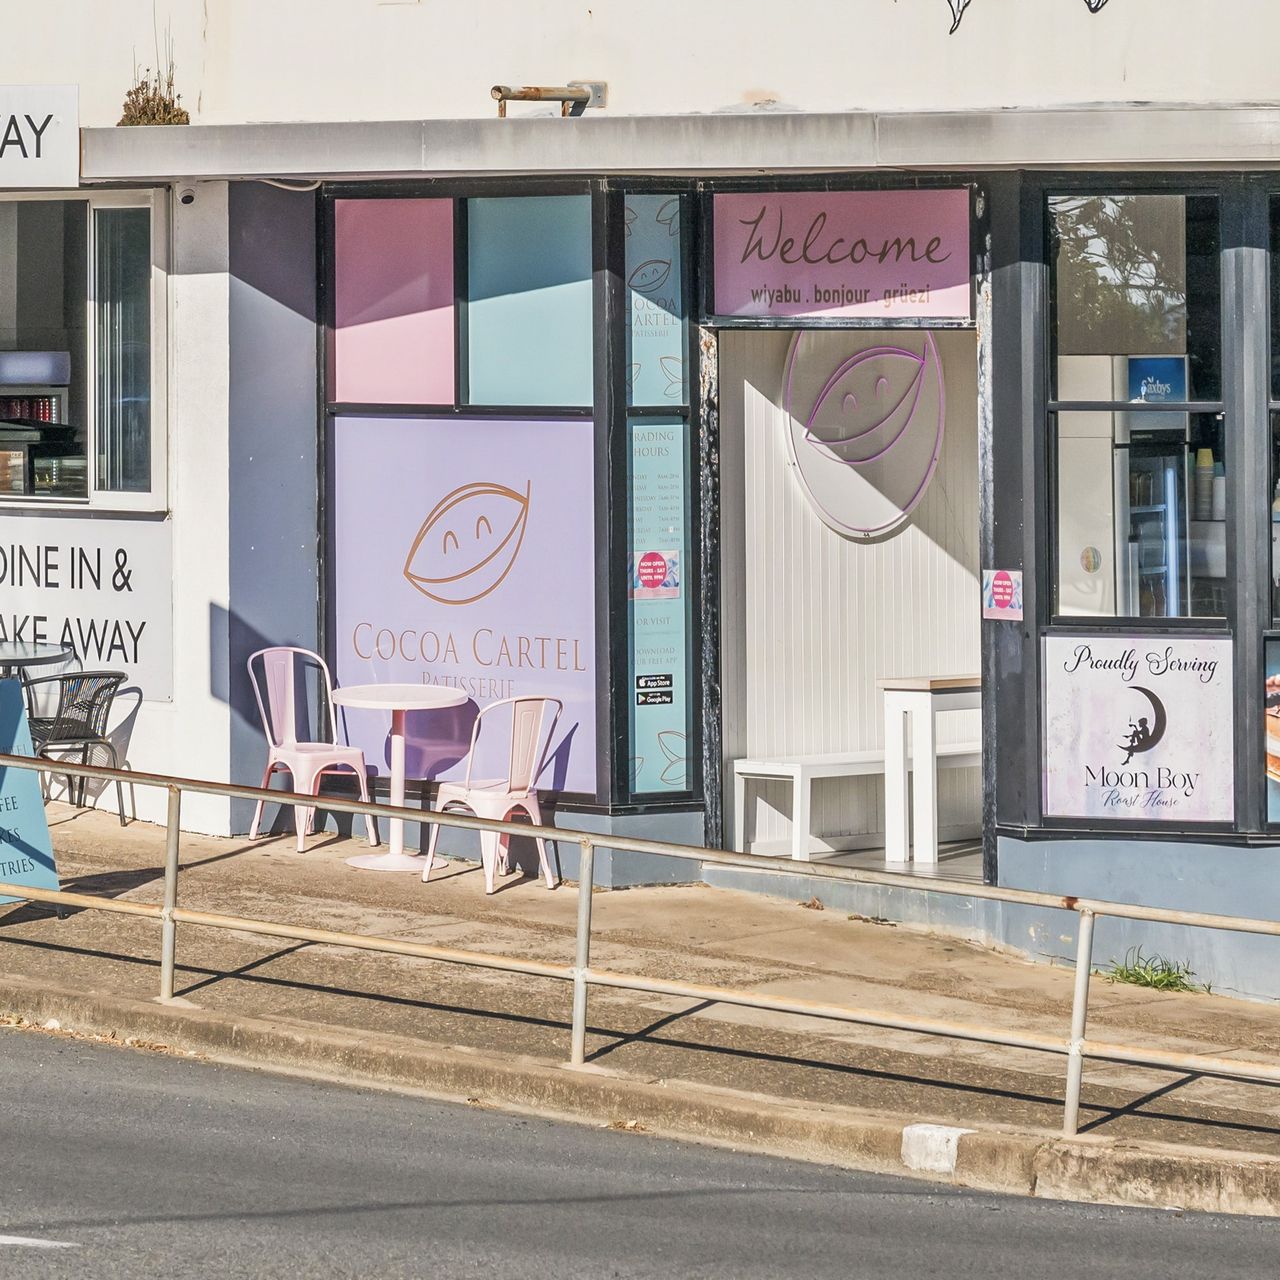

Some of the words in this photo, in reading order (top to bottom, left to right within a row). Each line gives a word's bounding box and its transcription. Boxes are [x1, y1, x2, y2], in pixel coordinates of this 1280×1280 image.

[738, 205, 952, 264] Welcome
[627, 297, 677, 311] OCOA
[751, 284, 801, 308] wiyabu
[815, 284, 870, 307] bonjour
[883, 284, 930, 308] grüezi
[627, 313, 679, 326] ARTEL
[631, 431, 674, 442] RADING
[70, 546, 101, 591] IN
[112, 548, 134, 593] &
[60, 617, 147, 664] AWAY
[353, 622, 460, 664] COCOA
[472, 628, 587, 672] CARTEL
[1063, 644, 1140, 682] Proudly
[1145, 646, 1219, 684] Serving
[1085, 765, 1149, 788] Moon
[1157, 767, 1200, 797] Boy
